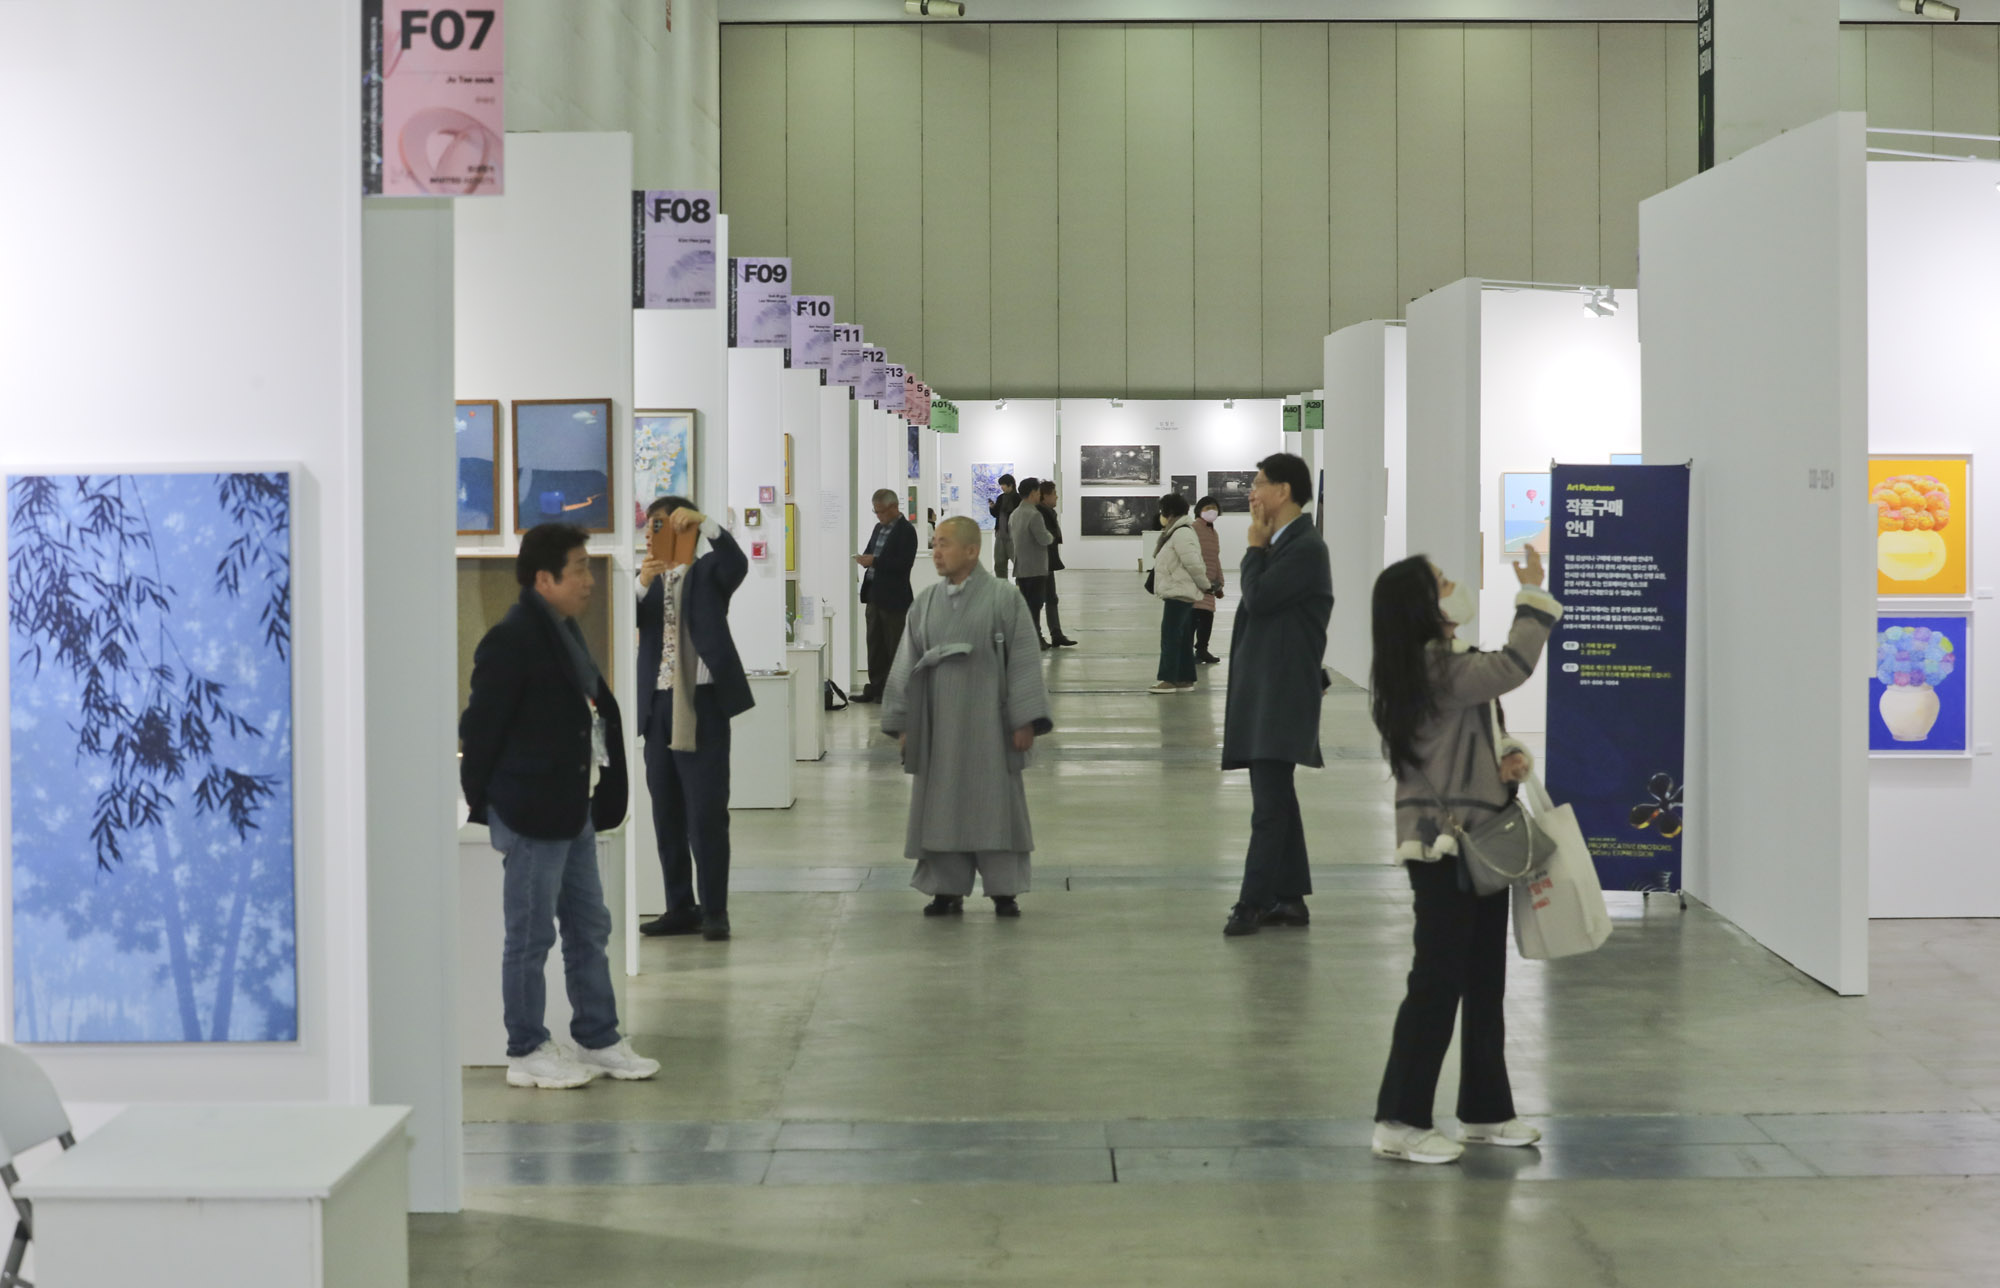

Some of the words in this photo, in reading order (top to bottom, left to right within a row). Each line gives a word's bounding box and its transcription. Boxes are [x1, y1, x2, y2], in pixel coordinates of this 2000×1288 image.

[401, 9, 495, 51] F07
[654, 198, 711, 223] F08
[744, 264, 787, 283] F09
[797, 301, 831, 317] F10
[833, 329, 860, 342] F11
[862, 351, 884, 363] F12
[1566, 499, 1623, 517] 작품구매
[1565, 520, 1594, 537] 안내
